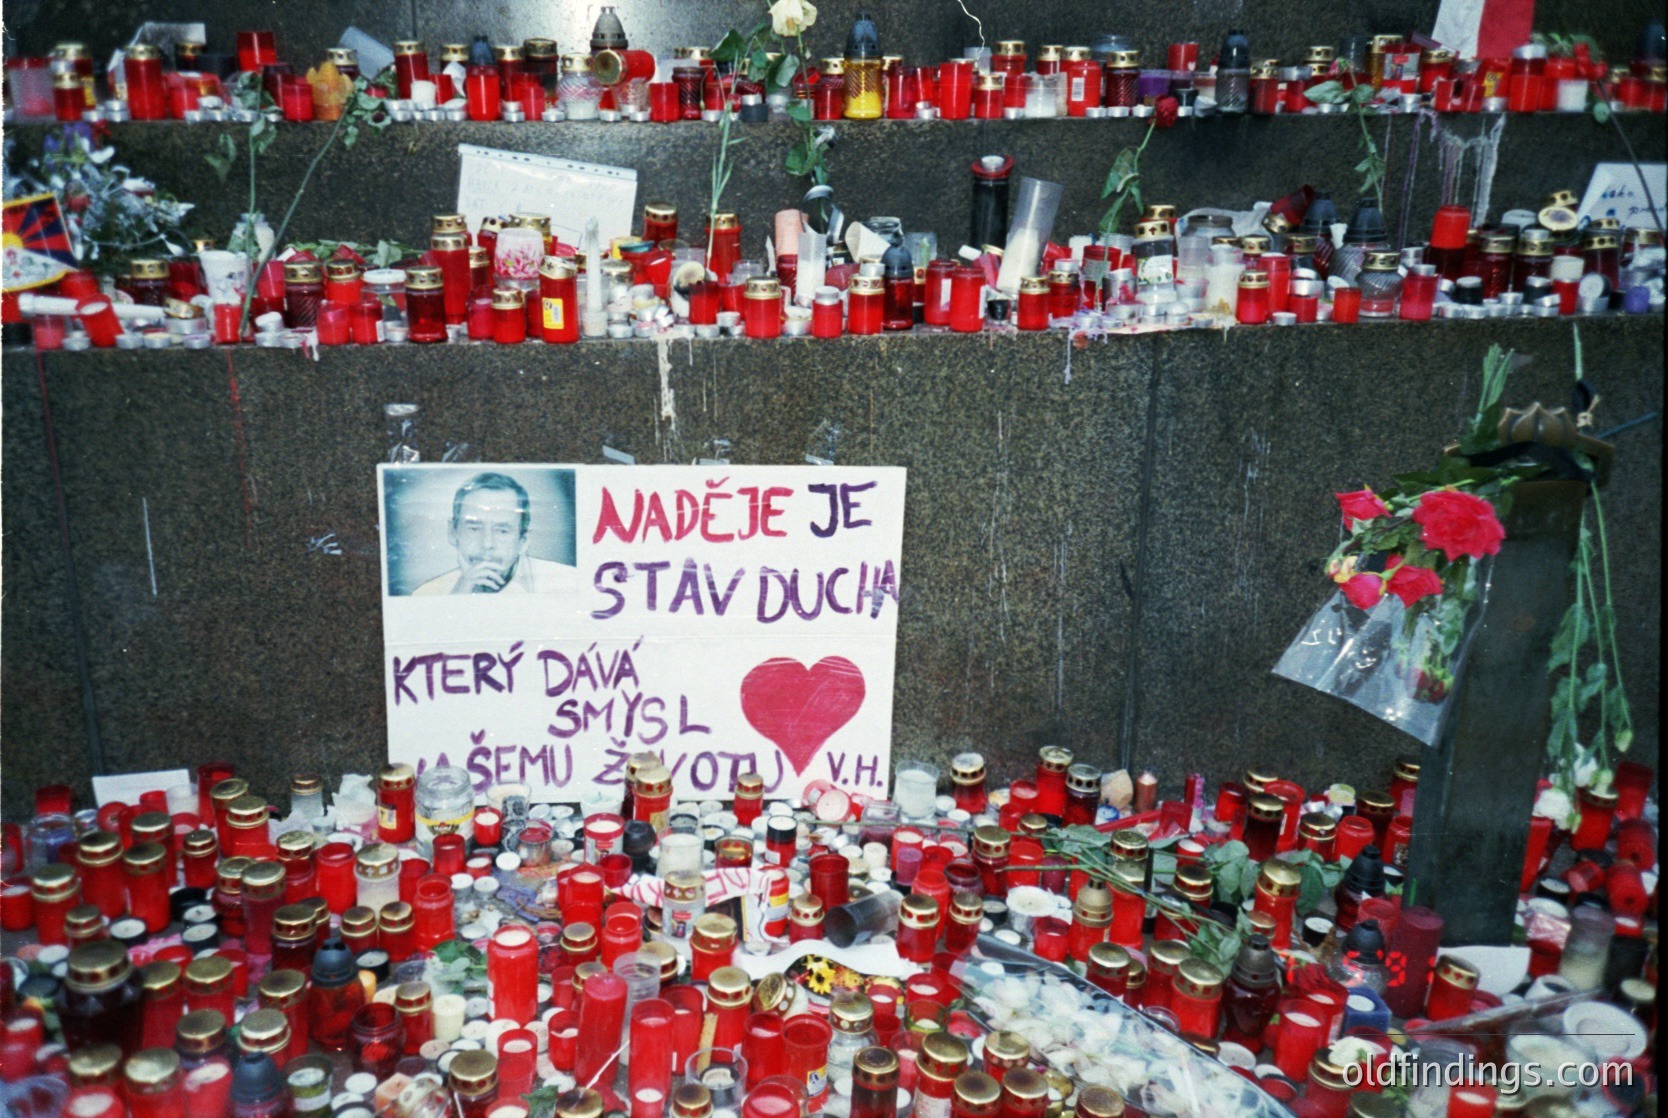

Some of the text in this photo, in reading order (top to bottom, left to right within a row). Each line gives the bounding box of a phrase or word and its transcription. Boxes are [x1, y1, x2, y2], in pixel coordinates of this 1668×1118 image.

[593, 476, 877, 544] NADĚJE JE
[591, 557, 900, 623] STAV DUCHA
[392, 635, 643, 706] KTERÝ DÁVÁ
[548, 689, 712, 745] SMYSL
